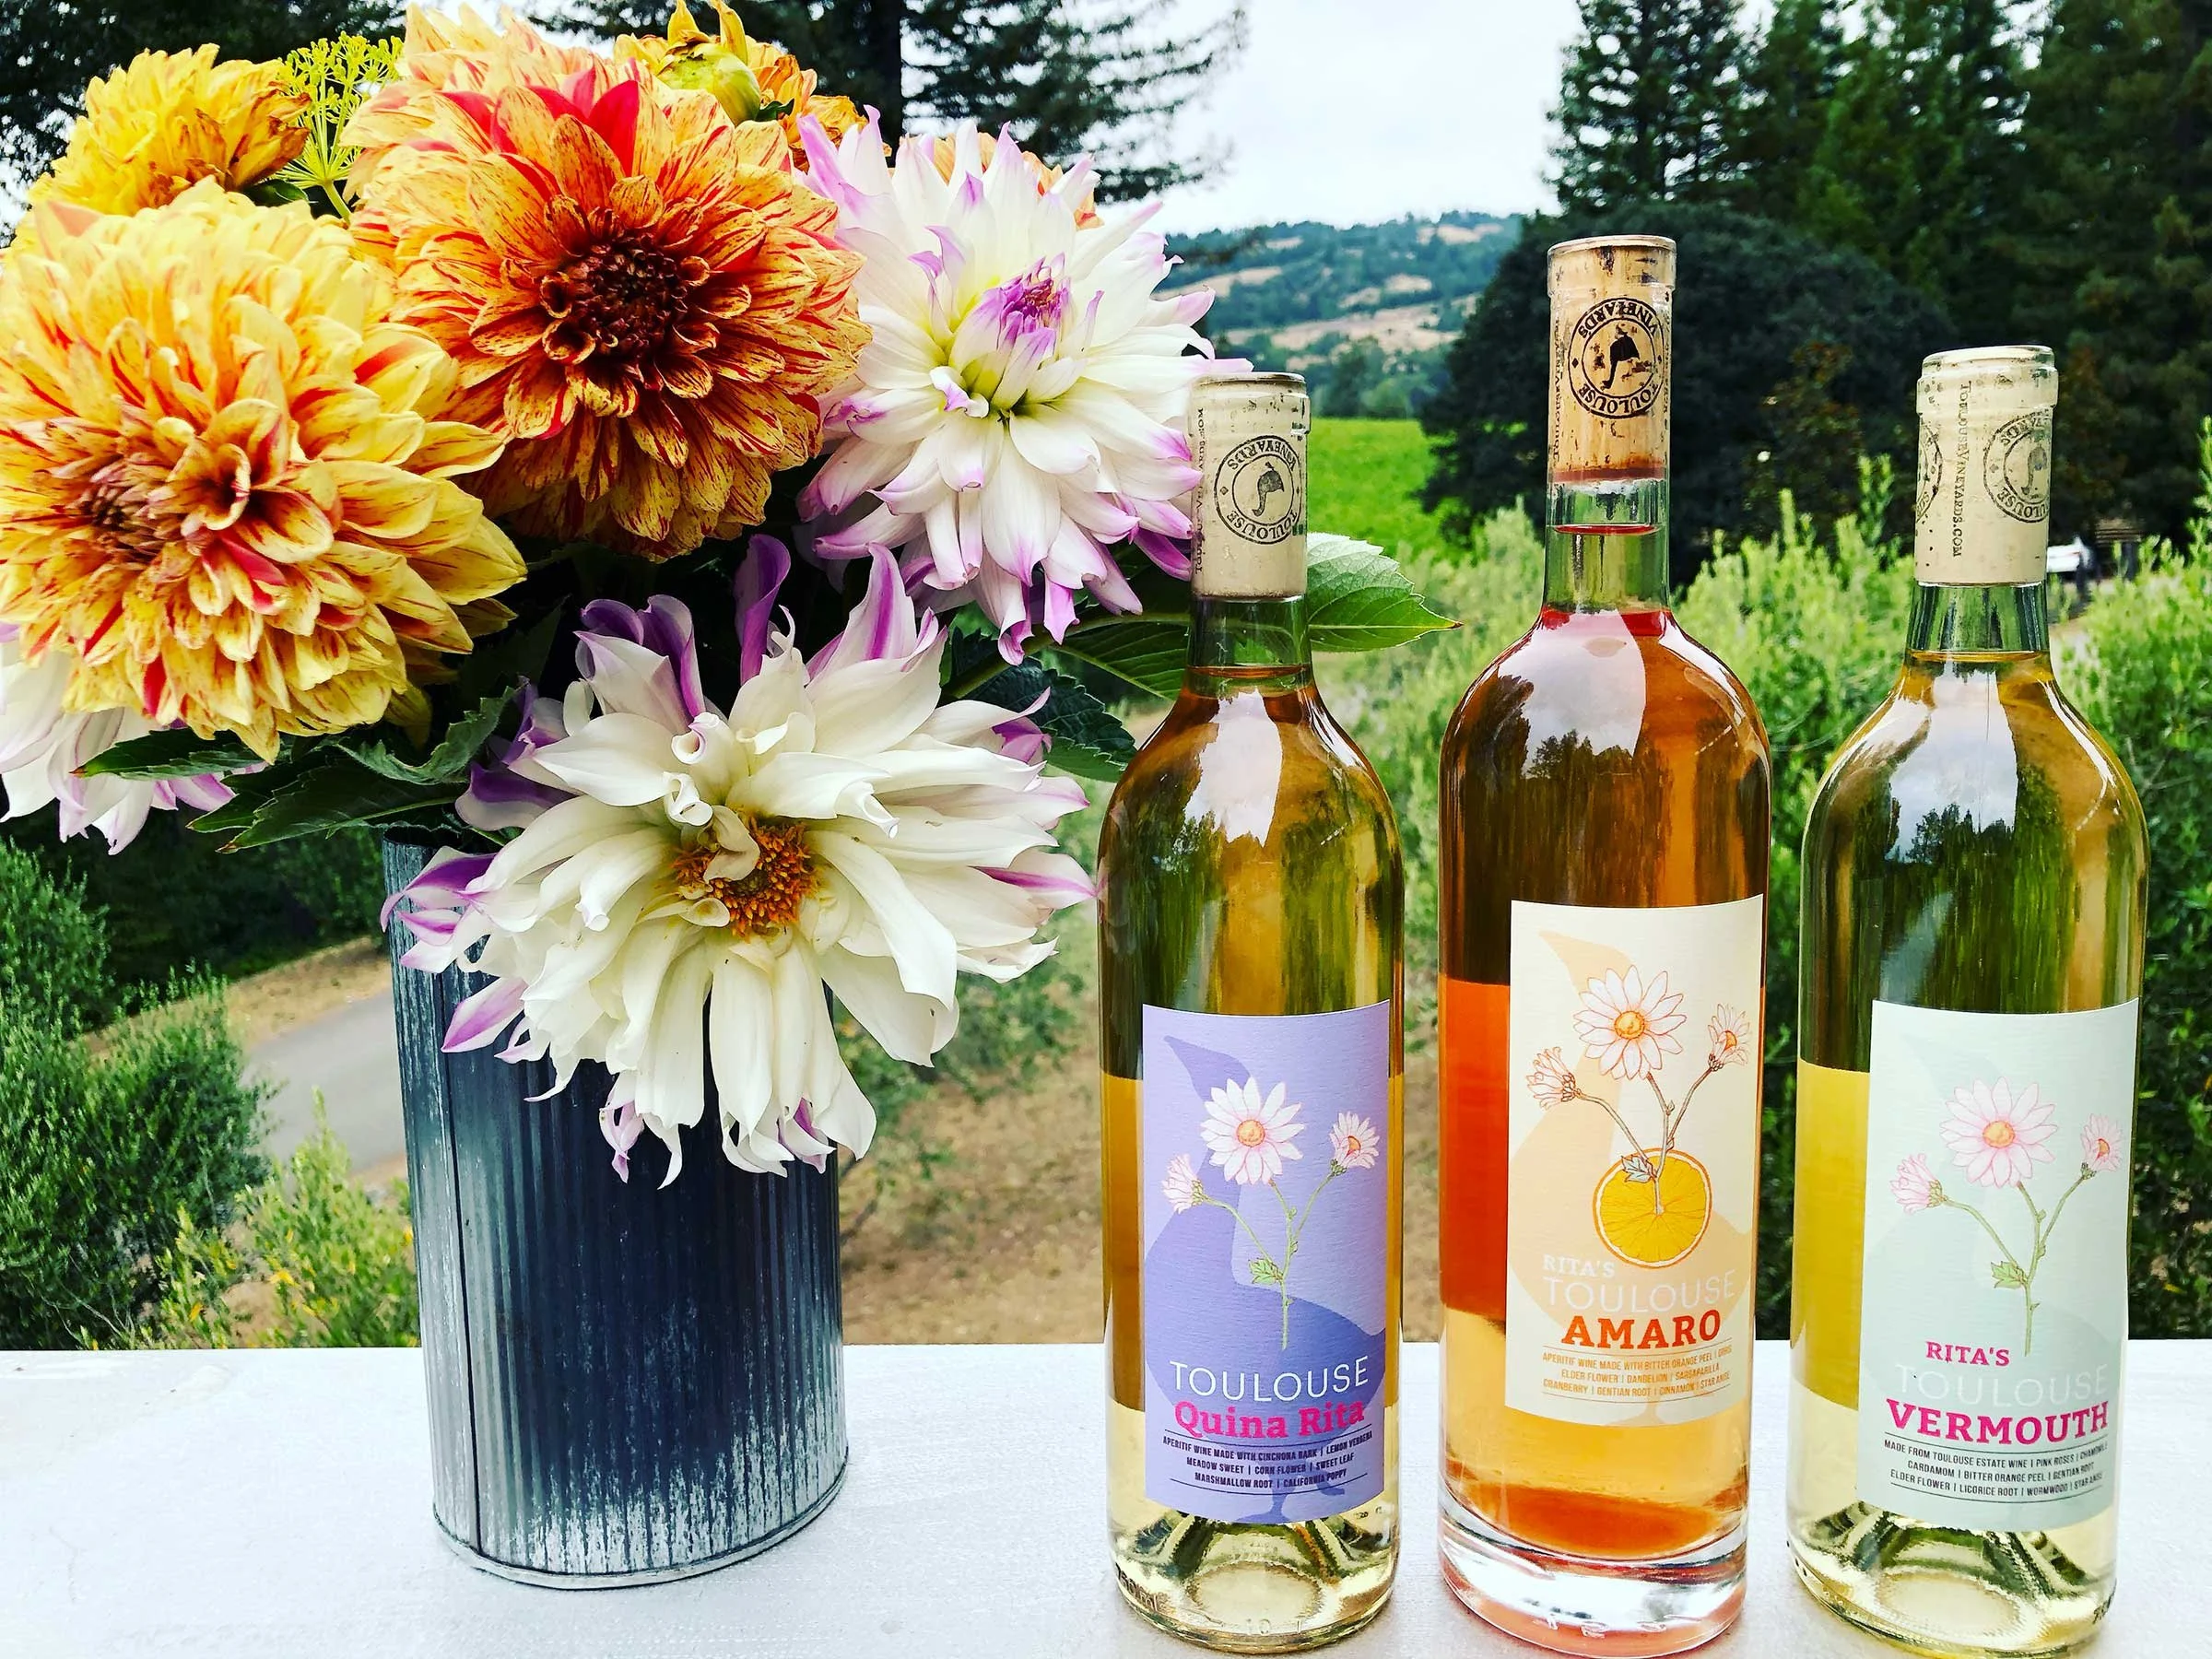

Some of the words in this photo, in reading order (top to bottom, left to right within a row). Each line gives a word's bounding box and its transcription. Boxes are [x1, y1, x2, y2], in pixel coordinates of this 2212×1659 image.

[1578, 381, 1659, 413] TOULOUSE
[1226, 508, 1299, 541] TOULOUSE
[1542, 1253, 1616, 1278] RITA'S
[1542, 1269, 1737, 1313] TOULOUSE
[1560, 1309, 1722, 1350] AMARO
[1578, 1358, 1597, 1369] WINE
[1599, 1360, 1621, 1371] MADE
[1624, 1360, 1643, 1371] WITH
[1644, 1360, 1670, 1371] BITTER
[1672, 1355, 1698, 1369] ORANGE
[1699, 1352, 1712, 1364] PEEL
[1924, 1341, 2011, 1368] RITA'S
[1170, 1355, 1369, 1402] TOULOUSE
[1543, 1378, 1588, 1394] CRANBERRY
[1596, 1386, 1630, 1397] GENTIAN
[1631, 1387, 1651, 1397] ROOT
[1561, 1369, 1585, 1380] ELDER
[1587, 1371, 1618, 1383] FLOWER
[1894, 1363, 2109, 1408] TOULOUSE
[1174, 1400, 1289, 1439] Quina
[1298, 1399, 1365, 1437] Rita
[1886, 1397, 2109, 1446] VERMOUTH
[1162, 1435, 1192, 1453] APERITIF
[1194, 1444, 1212, 1456] WINE
[1213, 1448, 1235, 1460] MADE
[1236, 1451, 1256, 1462] WITH
[1884, 1439, 1906, 1453] MADE
[1908, 1446, 1930, 1459] FROM
[1933, 1451, 1974, 1466] TOULOUSE
[1976, 1457, 2006, 1468] ESTATE
[2008, 1459, 2028, 1468] WINE
[2036, 1457, 2053, 1467] PINK
[1186, 1456, 1218, 1470] MEADOW
[1218, 1462, 1244, 1475] SWEET
[1254, 1465, 1276, 1476] CORN
[1277, 1464, 1306, 1475] FLOWER
[1315, 1457, 1338, 1471] SWEET
[1339, 1452, 1355, 1465] LEAF
[1194, 1471, 1252, 1488] MARSHMALLOW
[1253, 1478, 1273, 1488] ROOT
[1283, 1474, 1325, 1488] CALIFORNIA
[1326, 1468, 1347, 1481] POPPY
[1907, 1460, 1955, 1477] CARDAMOM
[1963, 1470, 1993, 1482] BITTER
[1994, 1472, 2026, 1483] ORANGE
[2028, 1472, 2045, 1483] PEEL
[2053, 1467, 2080, 1480] GENTIAN
[1890, 1468, 1916, 1484] ELDER
[1917, 1477, 1951, 1490] FLOWER
[1959, 1484, 1996, 1497] LICORICE
[1998, 1487, 2018, 1497] ROOT
[2027, 1483, 2068, 1497] WORMWOOD
